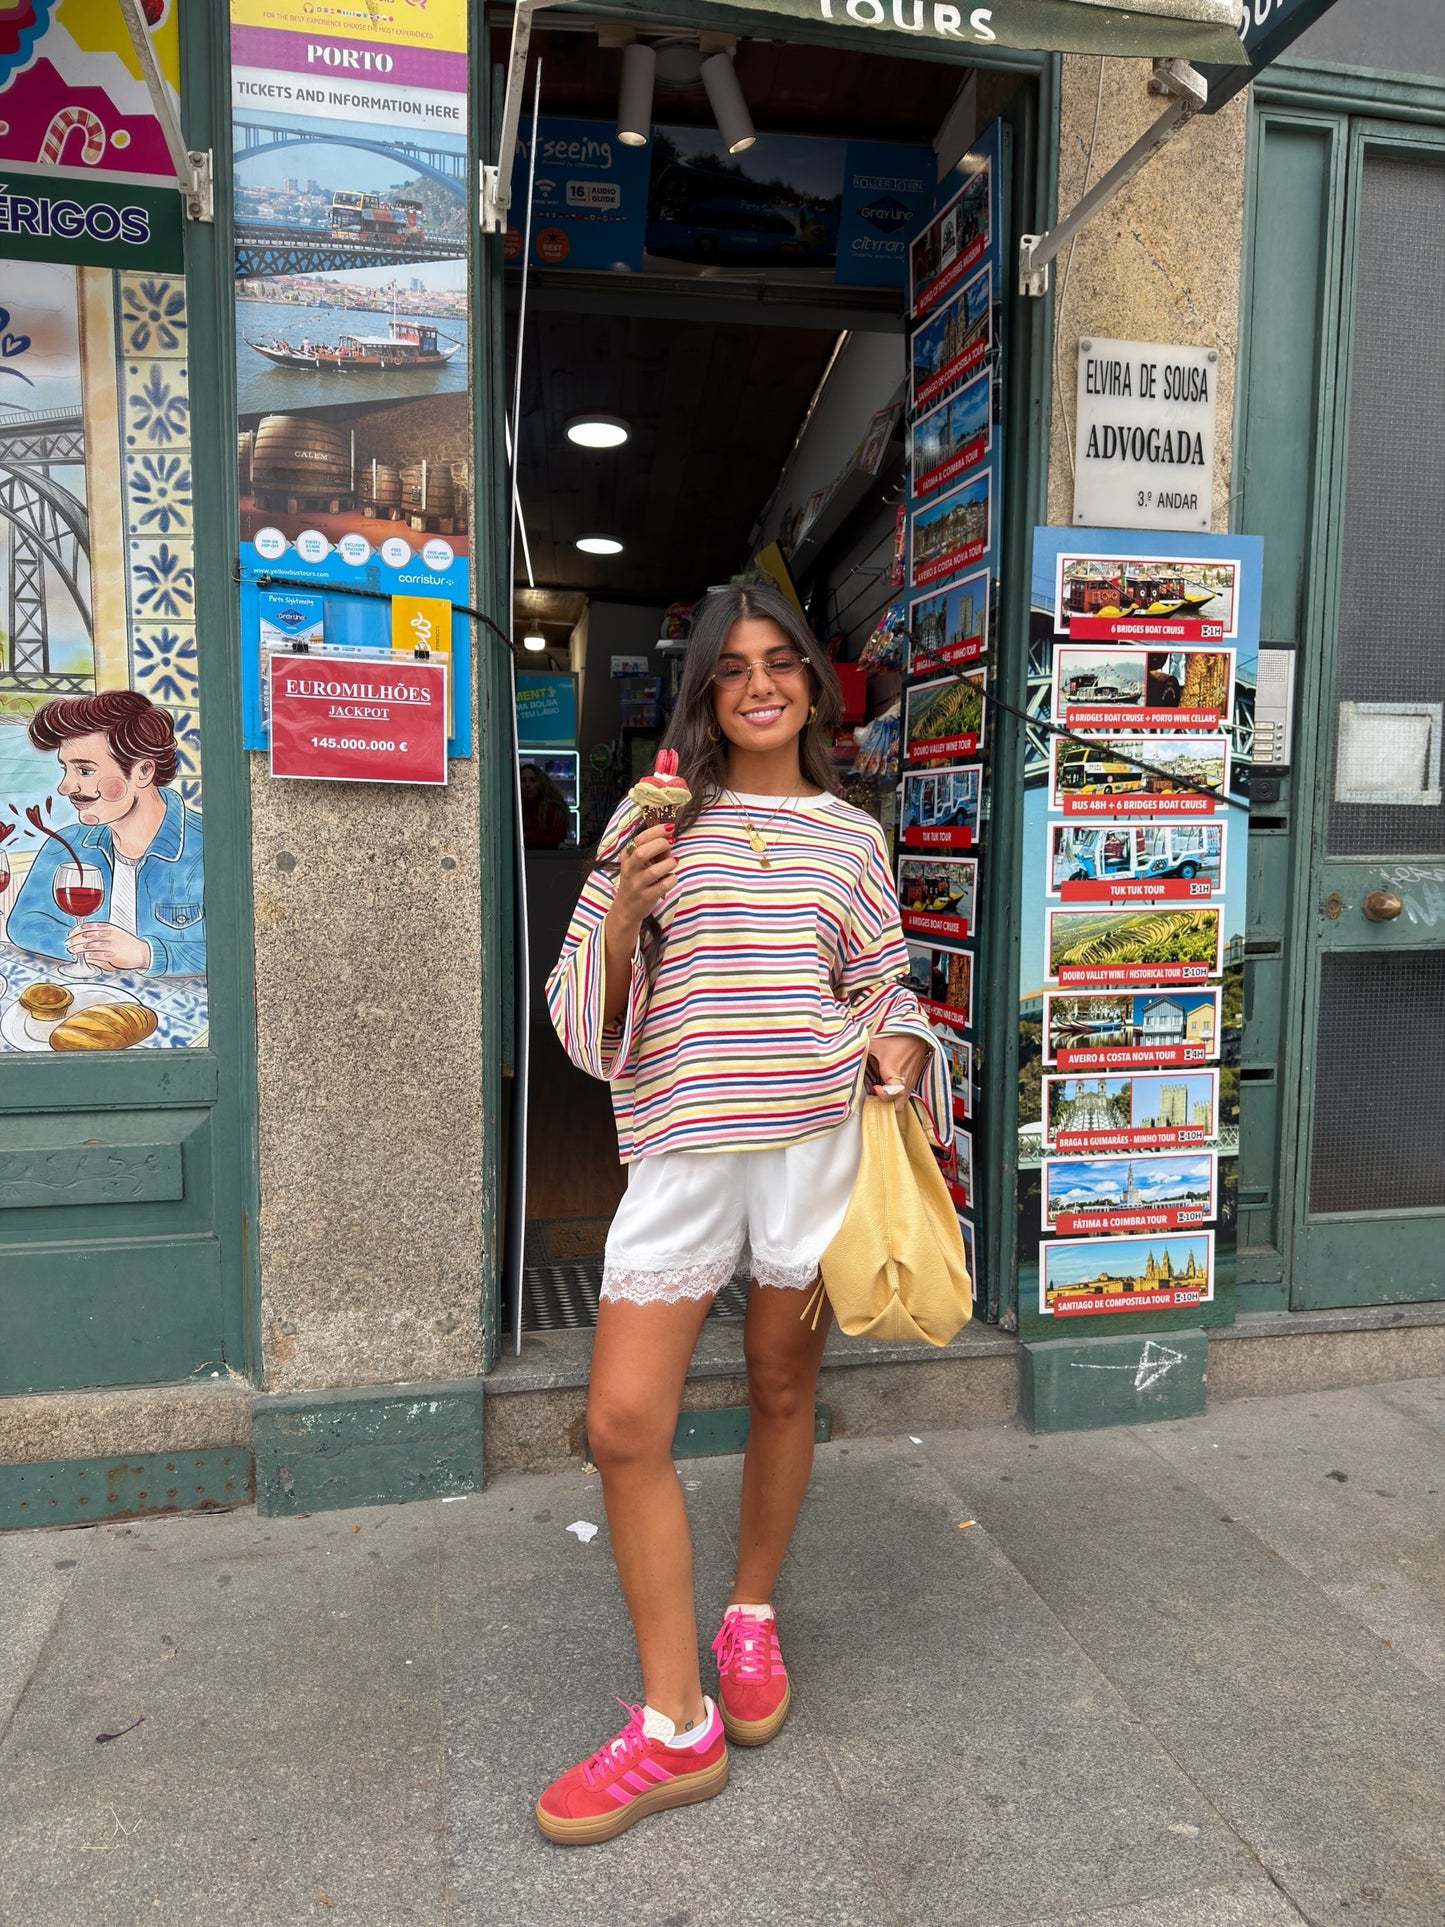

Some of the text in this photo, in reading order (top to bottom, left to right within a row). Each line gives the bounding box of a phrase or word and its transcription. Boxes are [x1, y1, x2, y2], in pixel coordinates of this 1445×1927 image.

[263, 11, 433, 40] FOR THE BEST EXPERIENCE CHOOSE THE MOST EXPERIENCED
[307, 44, 394, 73] PORTO
[237, 81, 460, 120] TICKETS AND INFORMATION HERE
[570, 186, 585, 197] 16
[592, 187, 616, 195] AUDIO
[972, 343, 984, 360] TOUR
[1086, 359, 1208, 402] ELVIRA DE SOUSA
[1086, 424, 1205, 466] ADVOGADA
[294, 450, 328, 461] CALEM
[965, 448, 978, 464] TOUR
[1157, 492, 1198, 510] ANDAR
[953, 551, 968, 565] NOVA
[968, 544, 982, 558] TOUR
[253, 568, 329, 578] www.yellowbustours.com
[398, 574, 445, 586] carristur
[1111, 625, 1221, 636] 6 BRIDGES BOAT CRUISE 1H
[966, 644, 976, 656] TOUR
[286, 679, 431, 702] EUROMILHÕES
[530, 698, 558, 709] BOLSA
[328, 705, 390, 718] JACKPOT
[1070, 714, 1074, 722] 6
[1075, 714, 1103, 722] BRIDGES
[1104, 714, 1121, 722] BOAT
[1122, 714, 1145, 722] CRUISE
[1152, 714, 1172, 722] PORTO
[1174, 714, 1190, 722] WINE
[1191, 714, 1216, 723] CELLARS
[311, 737, 408, 752] 145.000.000 €
[958, 739, 971, 750] TOUR
[1072, 800, 1088, 810] BUS
[1090, 800, 1106, 810] 48H
[1116, 800, 1122, 810] 6
[1124, 800, 1157, 810] BRIDGES
[1159, 800, 1178, 809] BOAT
[1180, 800, 1207, 809] CRUISE
[922, 832, 930, 841] TUK
[939, 832, 952, 842] TOUR
[1110, 884, 1209, 895] TUK TUK TOUR 1H
[930, 919, 943, 930] BOAT
[943, 921, 960, 932] CRUISE
[1062, 972, 1085, 981] DOURO
[1086, 971, 1107, 980] VALLEY
[1107, 970, 1125, 979] WINE
[1130, 969, 1164, 979] HISTORICAL
[1165, 969, 1180, 978] TOUR
[1191, 968, 1206, 977] 10H
[1068, 1050, 1203, 1063] AVEIRO & COSTA NOVA TOUR 4H
[1059, 1137, 1082, 1147] BRAGA
[1083, 1137, 1088, 1146] &
[1090, 1134, 1129, 1145] GUIMARÃES
[1133, 1134, 1157, 1144] MINHO
[1157, 1133, 1176, 1142] TOUR
[1187, 1131, 1202, 1140] 10H
[1073, 1212, 1201, 1229] FÁTIMA & COIMBRA TOUR 10H
[1058, 1292, 1198, 1312] SANTIAGO DE COMPOSTELA TOUR 10H
